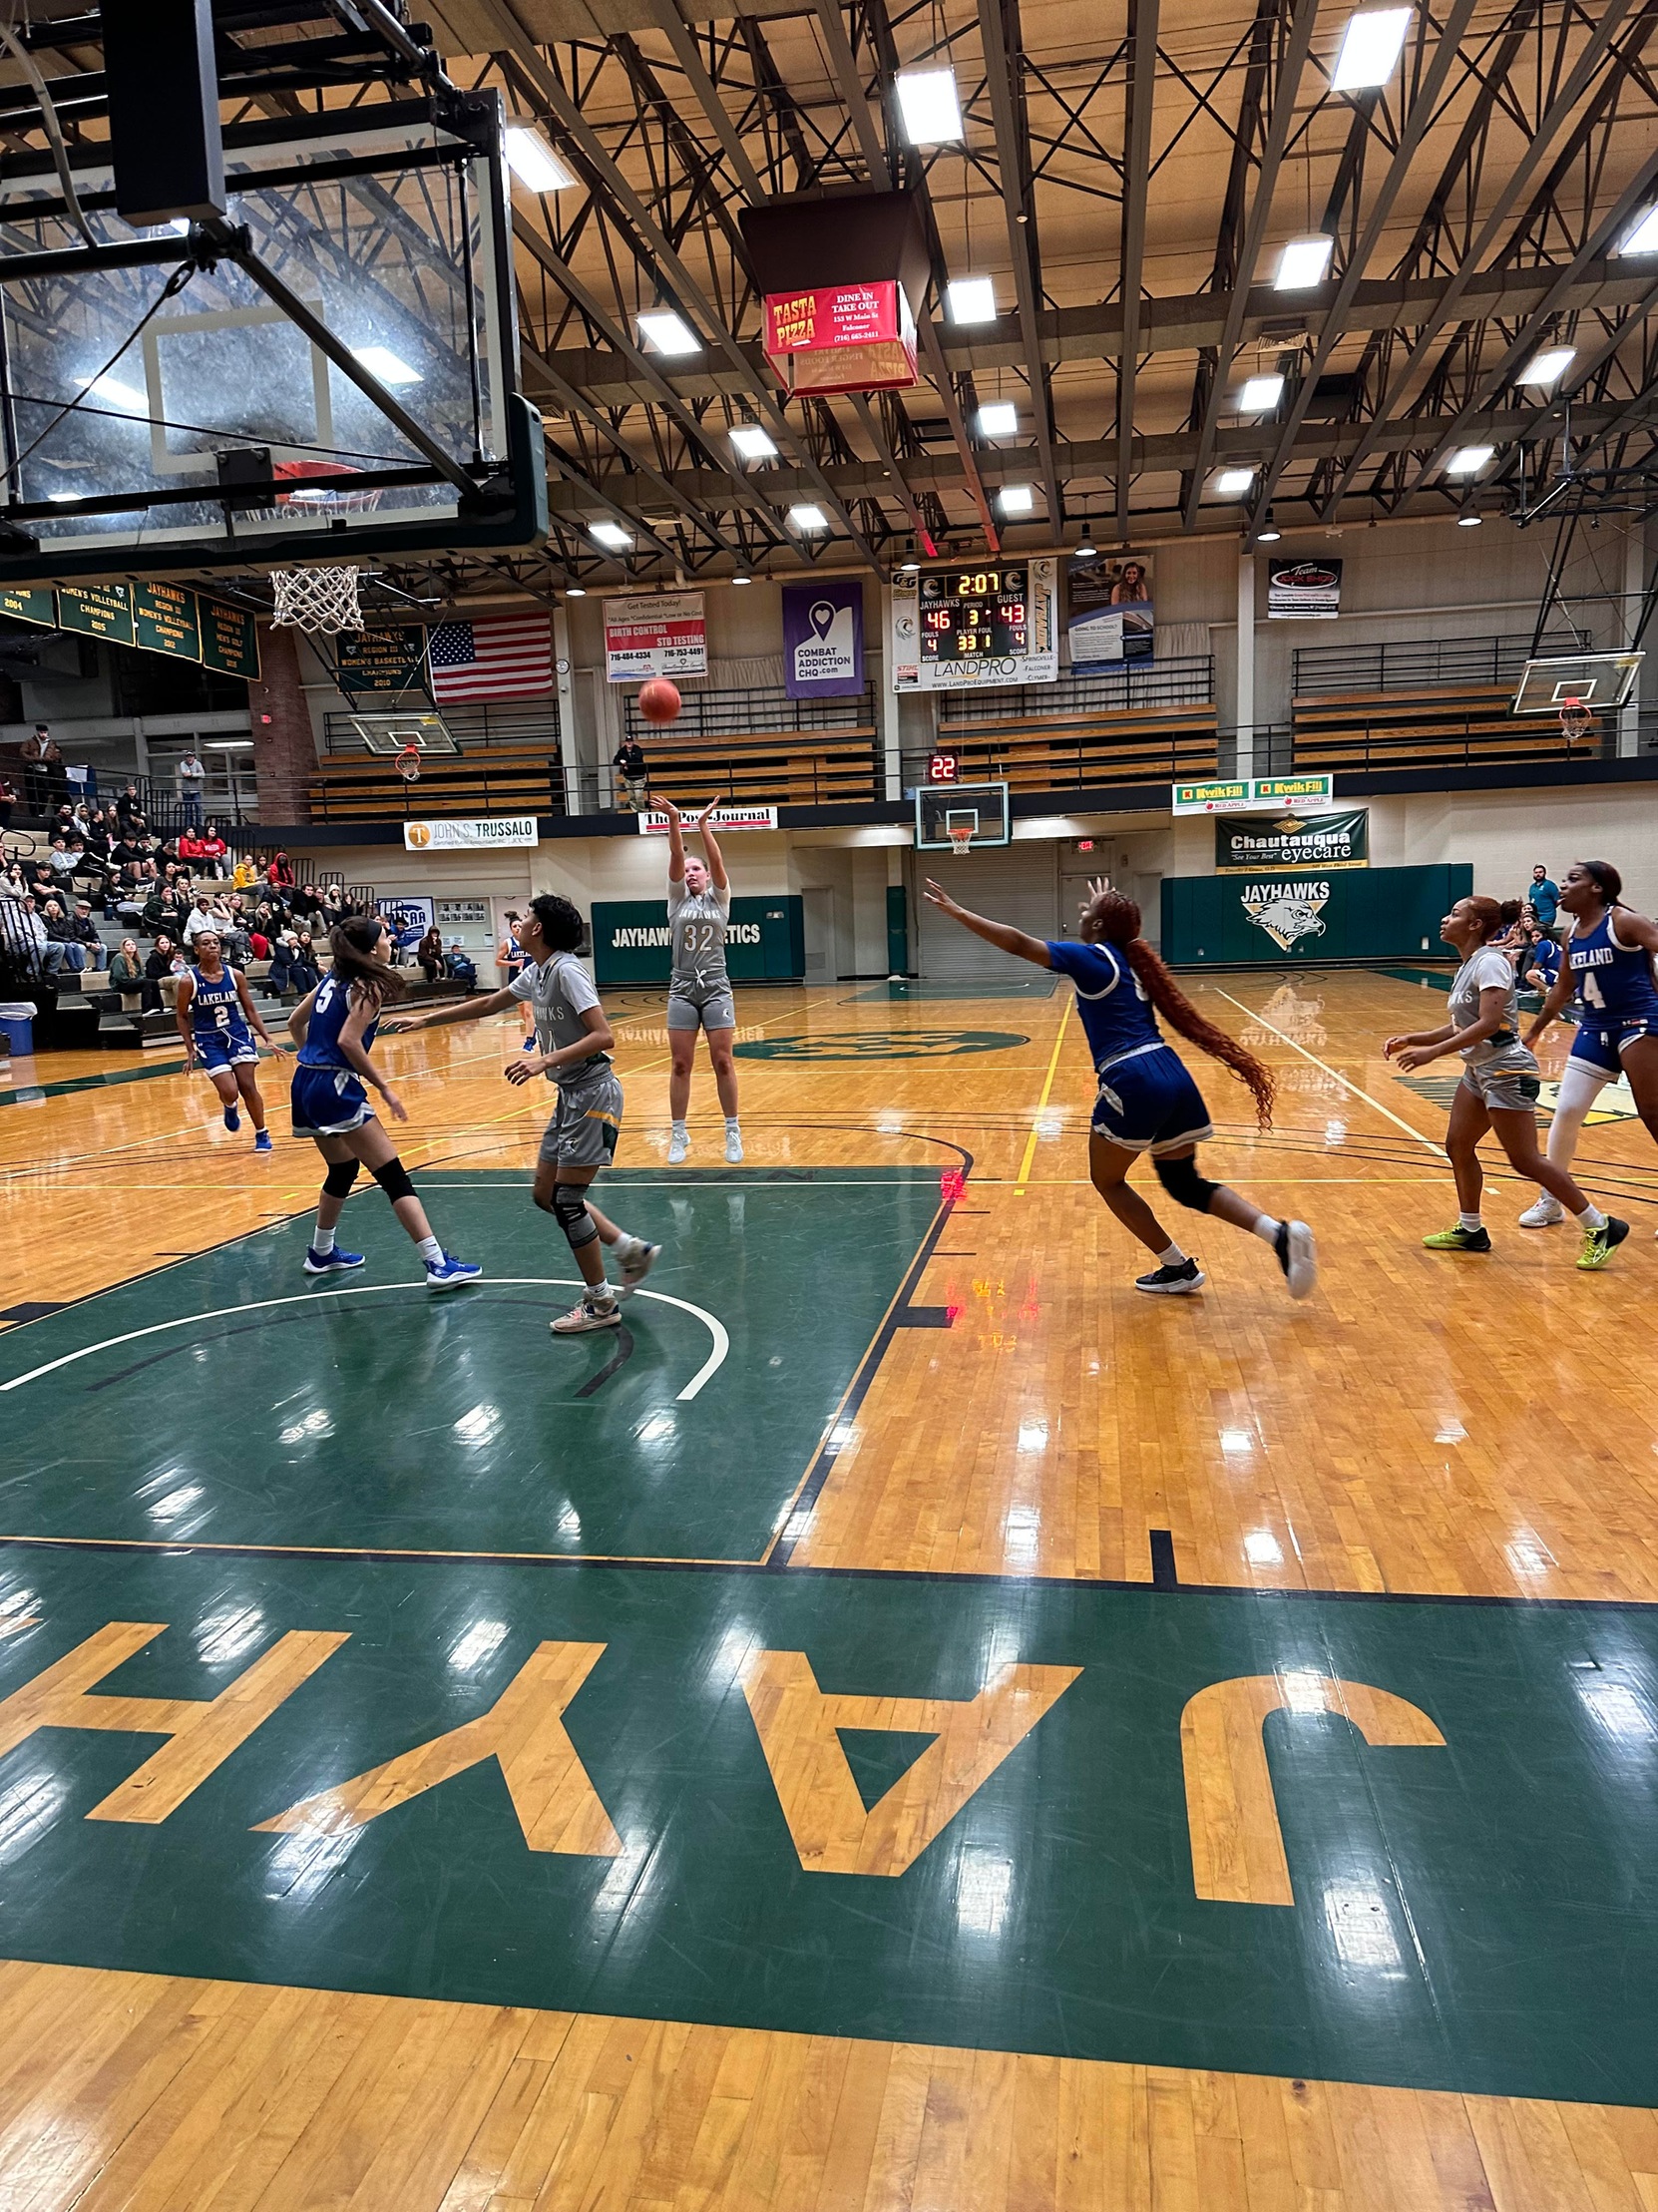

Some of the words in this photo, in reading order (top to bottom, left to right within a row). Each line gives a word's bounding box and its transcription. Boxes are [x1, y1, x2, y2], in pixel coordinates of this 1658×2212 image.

[836, 293, 861, 304] DINE
[862, 291, 874, 301] IN
[773, 295, 817, 325] TASTA
[831, 302, 857, 313] TAKE
[857, 300, 880, 310] OUT
[777, 318, 816, 349] PIZZA
[842, 323, 871, 332] Falconer
[834, 333, 850, 343] (716)
[1290, 562, 1318, 576] Team
[959, 573, 999, 596] 2:07
[147, 582, 186, 604] JAYHAWKS
[997, 594, 1024, 604] GUEST
[4, 597, 23, 611] 2004
[90, 592, 129, 612] VOLLEYBALL
[660, 599, 681, 608] Today!
[920, 598, 961, 611] JAYHAWKS
[80, 604, 116, 621] CHAMPIONS
[139, 607, 163, 621] WOMEN'S
[210, 606, 245, 626] JAYHAWKS
[927, 610, 951, 630] 46
[970, 610, 979, 626] 3
[1001, 604, 1026, 624] 43
[155, 625, 185, 640] CHAMPIONS
[609, 626, 631, 638] BIRTH
[632, 624, 668, 636] CONTROL
[1015, 632, 1025, 646] 4
[656, 637, 672, 648] STD
[673, 635, 704, 646] TESTING
[927, 639, 938, 652] 4
[958, 635, 978, 651] 33
[985, 634, 991, 648] 1
[798, 648, 837, 658] COMBAT
[341, 658, 372, 666] WOMEN'S
[798, 657, 851, 667] ADDICTION
[934, 658, 1017, 677] LANDPRO
[799, 666, 839, 678] CHQ.com
[374, 678, 392, 687] 2010
[931, 757, 956, 779] 22
[644, 813, 669, 824] The
[678, 808, 771, 823] Pos-Journal
[433, 823, 461, 840] JOHN
[463, 823, 473, 838] S.
[475, 821, 533, 837] TRUSSALO
[1230, 831, 1351, 850] Chautauqua
[1281, 844, 1352, 863] eyecare
[1240, 881, 1331, 903] JAYHAWKS
[678, 907, 721, 920] JAYHAWKS
[612, 927, 673, 948] JAYHAW
[683, 924, 715, 952] 32
[315, 978, 337, 1015] 5
[1582, 972, 1606, 1010] 4
[213, 1005, 230, 1029] 2
[0, 1615, 1448, 1908] JAYH
